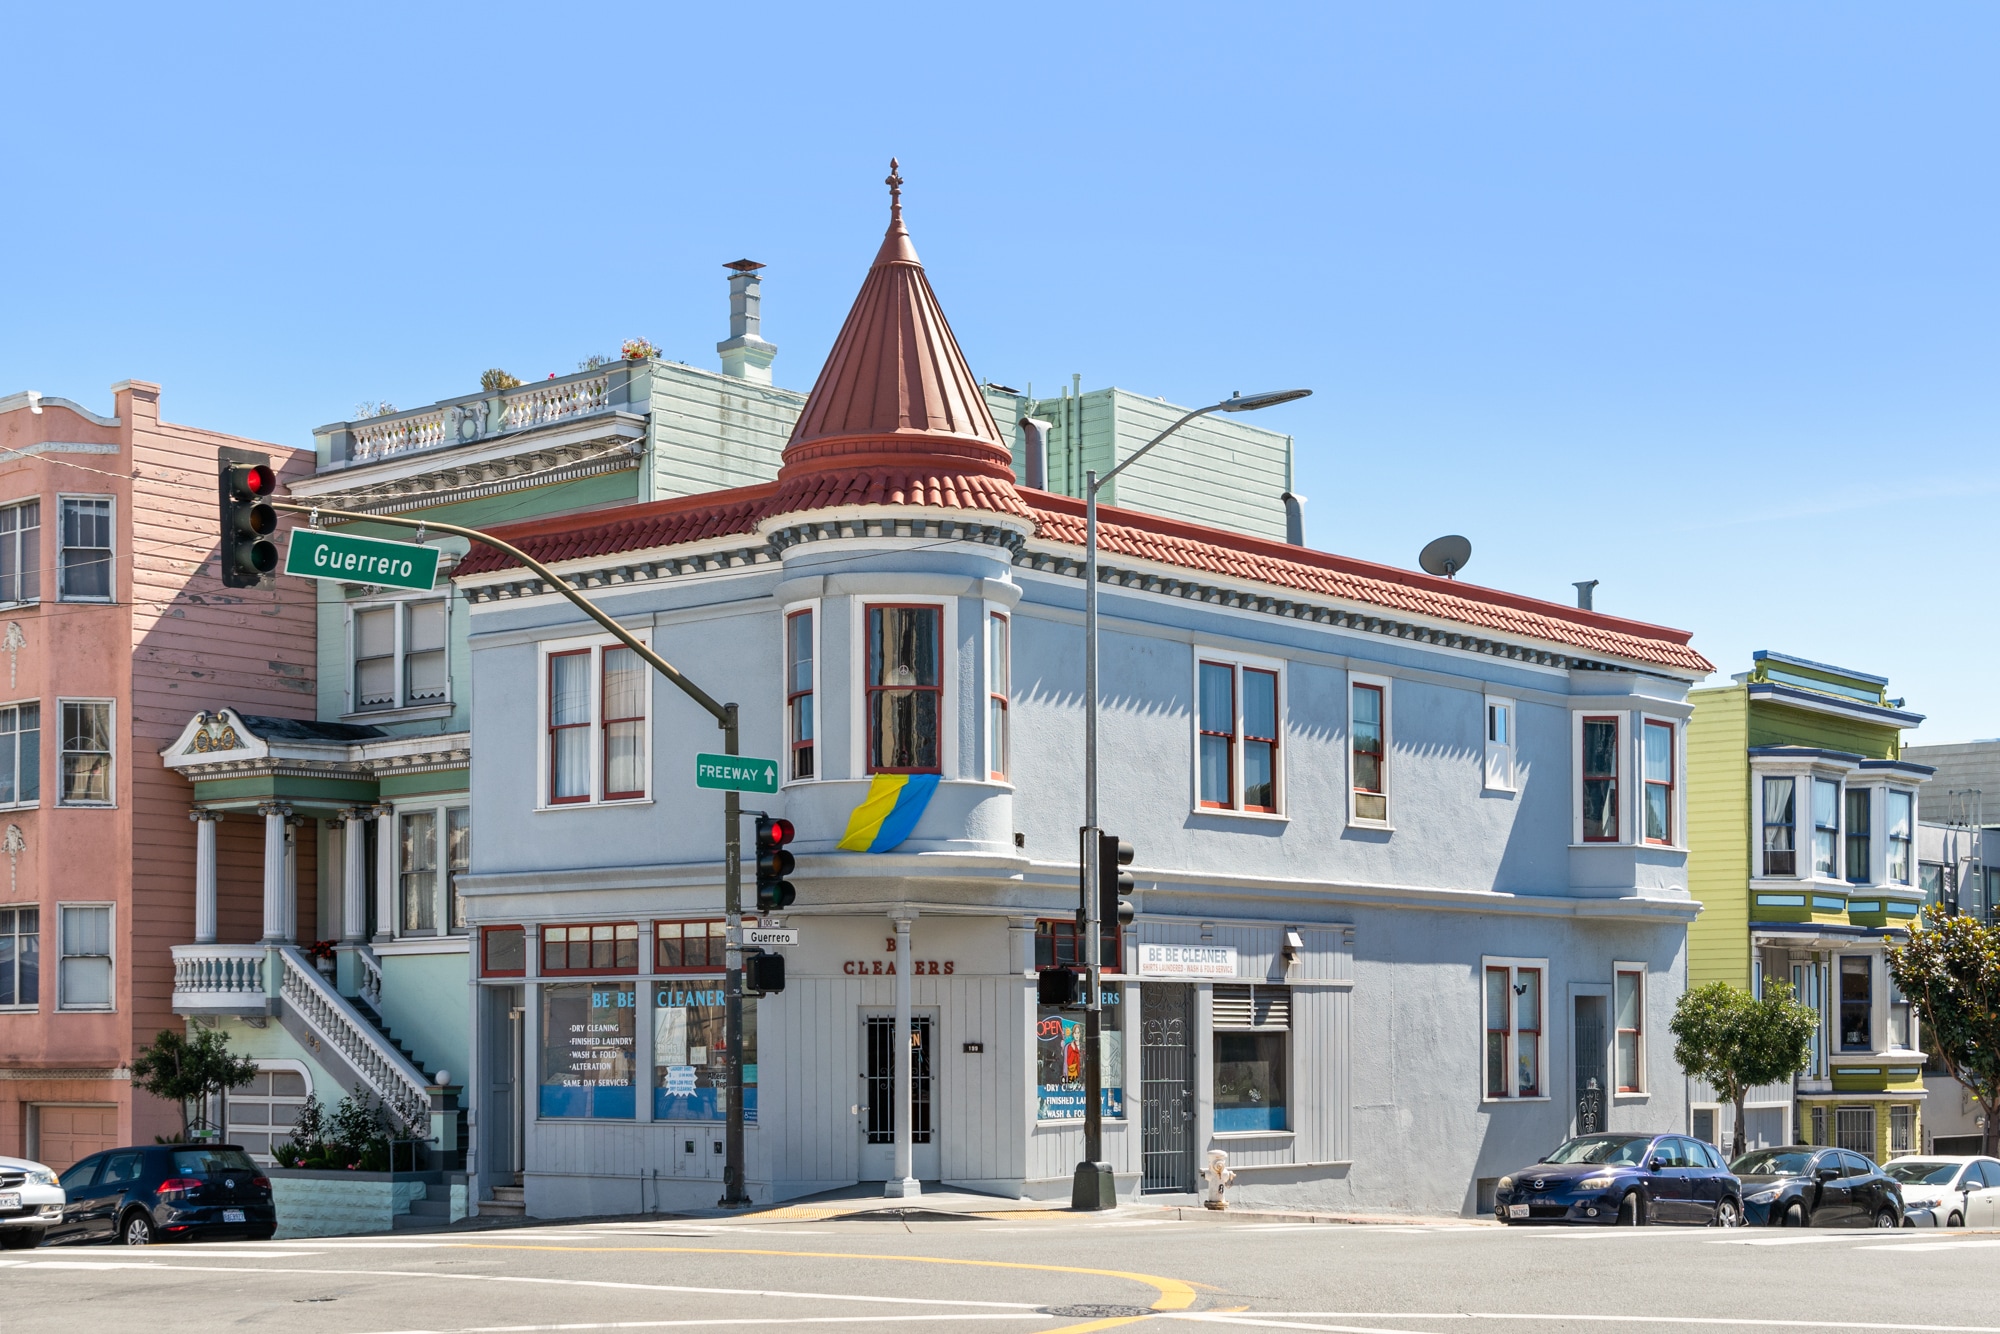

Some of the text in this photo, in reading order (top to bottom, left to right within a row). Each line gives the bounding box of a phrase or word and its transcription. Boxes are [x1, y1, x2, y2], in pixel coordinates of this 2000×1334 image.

[314, 544, 412, 577] Guerrero
[699, 764, 758, 781] FREEWAY
[763, 919, 773, 927] 100
[751, 931, 790, 942] Guerrero
[1149, 948, 1227, 963] BE BE CLEANER
[843, 961, 954, 975] CLEAERS
[1142, 963, 1158, 972] SHIRTS
[1159, 964, 1184, 972] LAUNDERED
[1186, 964, 1199, 973] WASH
[1204, 965, 1214, 973] FOLD
[1215, 965, 1233, 974] SERVICE
[593, 992, 609, 1008] BE
[617, 992, 635, 1008] BE
[587, 1023, 619, 1032] CLEANING
[1037, 1020, 1063, 1036] OPEN
[602, 1037, 633, 1045] LAUNDRY
[592, 1051, 597, 1059] &
[600, 1050, 617, 1059] FOLD
[563, 1078, 629, 1087] SAME DAY SERVICES
[1046, 1096, 1075, 1105] FINISHED
[1074, 1109, 1086, 1117] FOL
